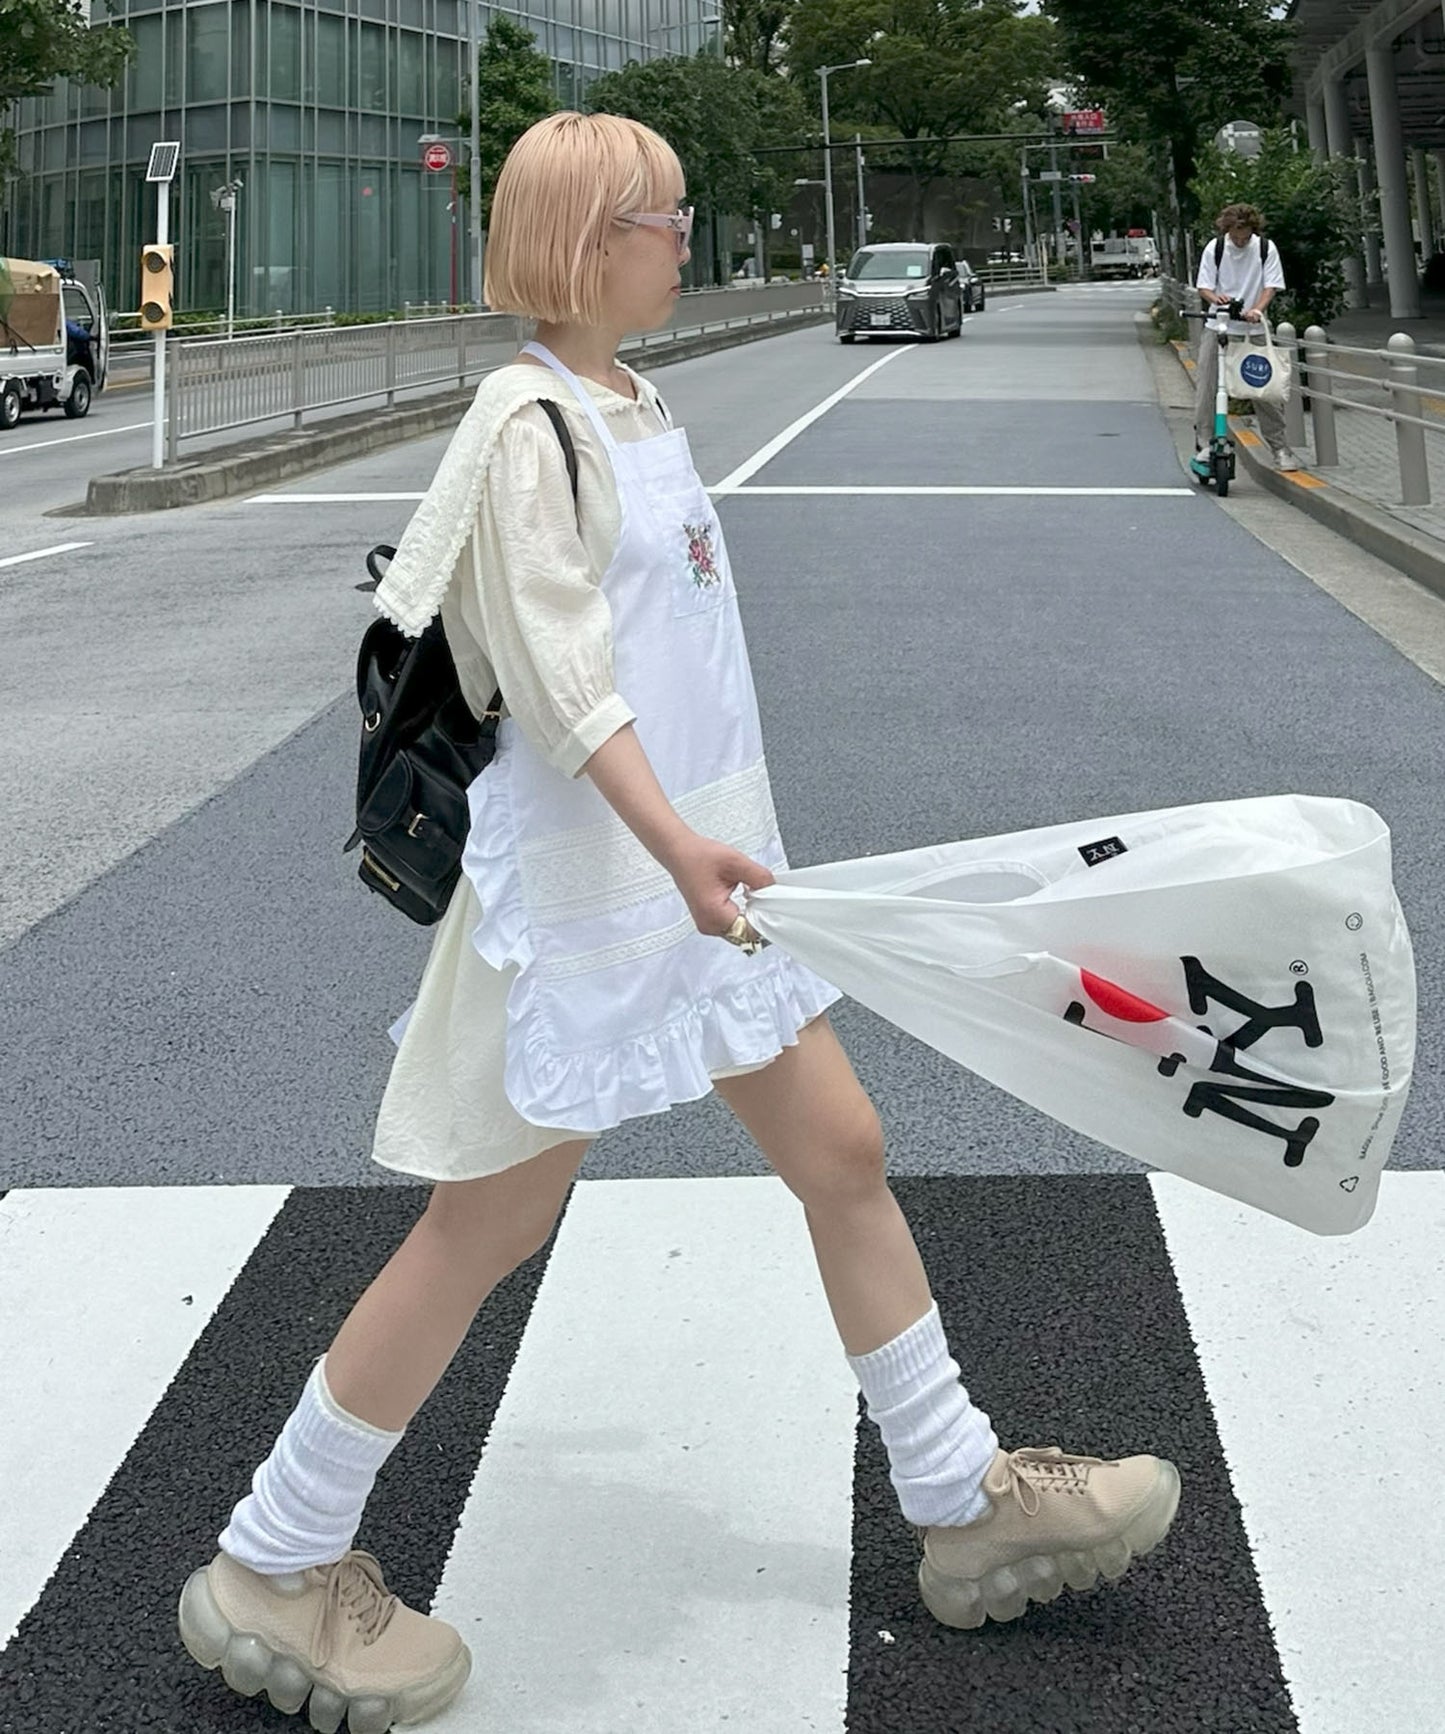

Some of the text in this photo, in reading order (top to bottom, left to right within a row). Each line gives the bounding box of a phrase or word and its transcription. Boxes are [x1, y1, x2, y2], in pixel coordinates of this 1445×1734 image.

[1086, 842, 1120, 861] NY
[1376, 1035, 1386, 1055] AND
[1380, 1056, 1390, 1081] GOOD
